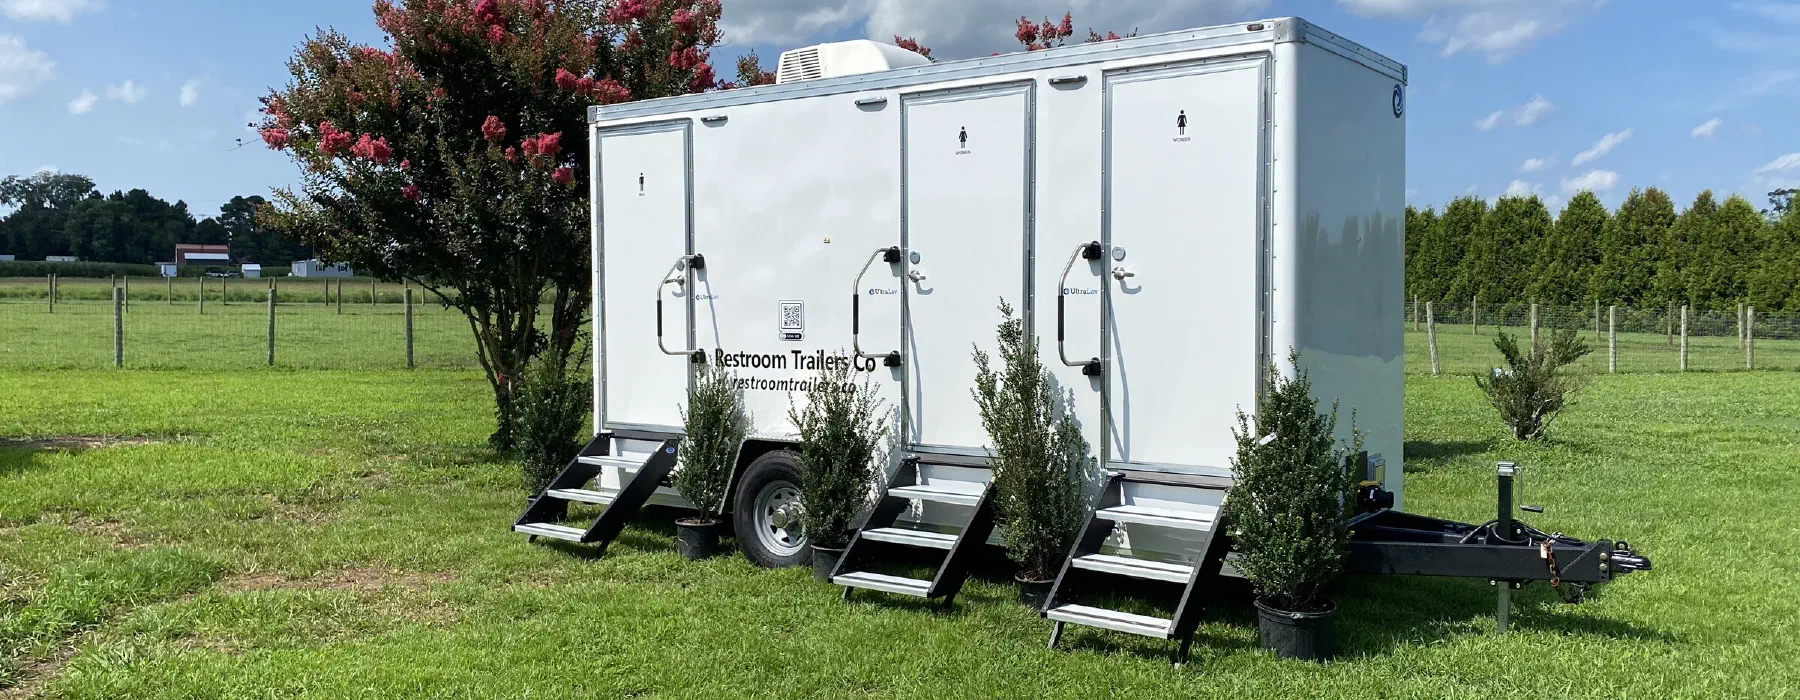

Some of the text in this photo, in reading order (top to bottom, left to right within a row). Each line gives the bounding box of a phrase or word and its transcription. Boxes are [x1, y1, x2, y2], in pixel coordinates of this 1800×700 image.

[715, 348, 876, 373] Restroom Trailers Co
